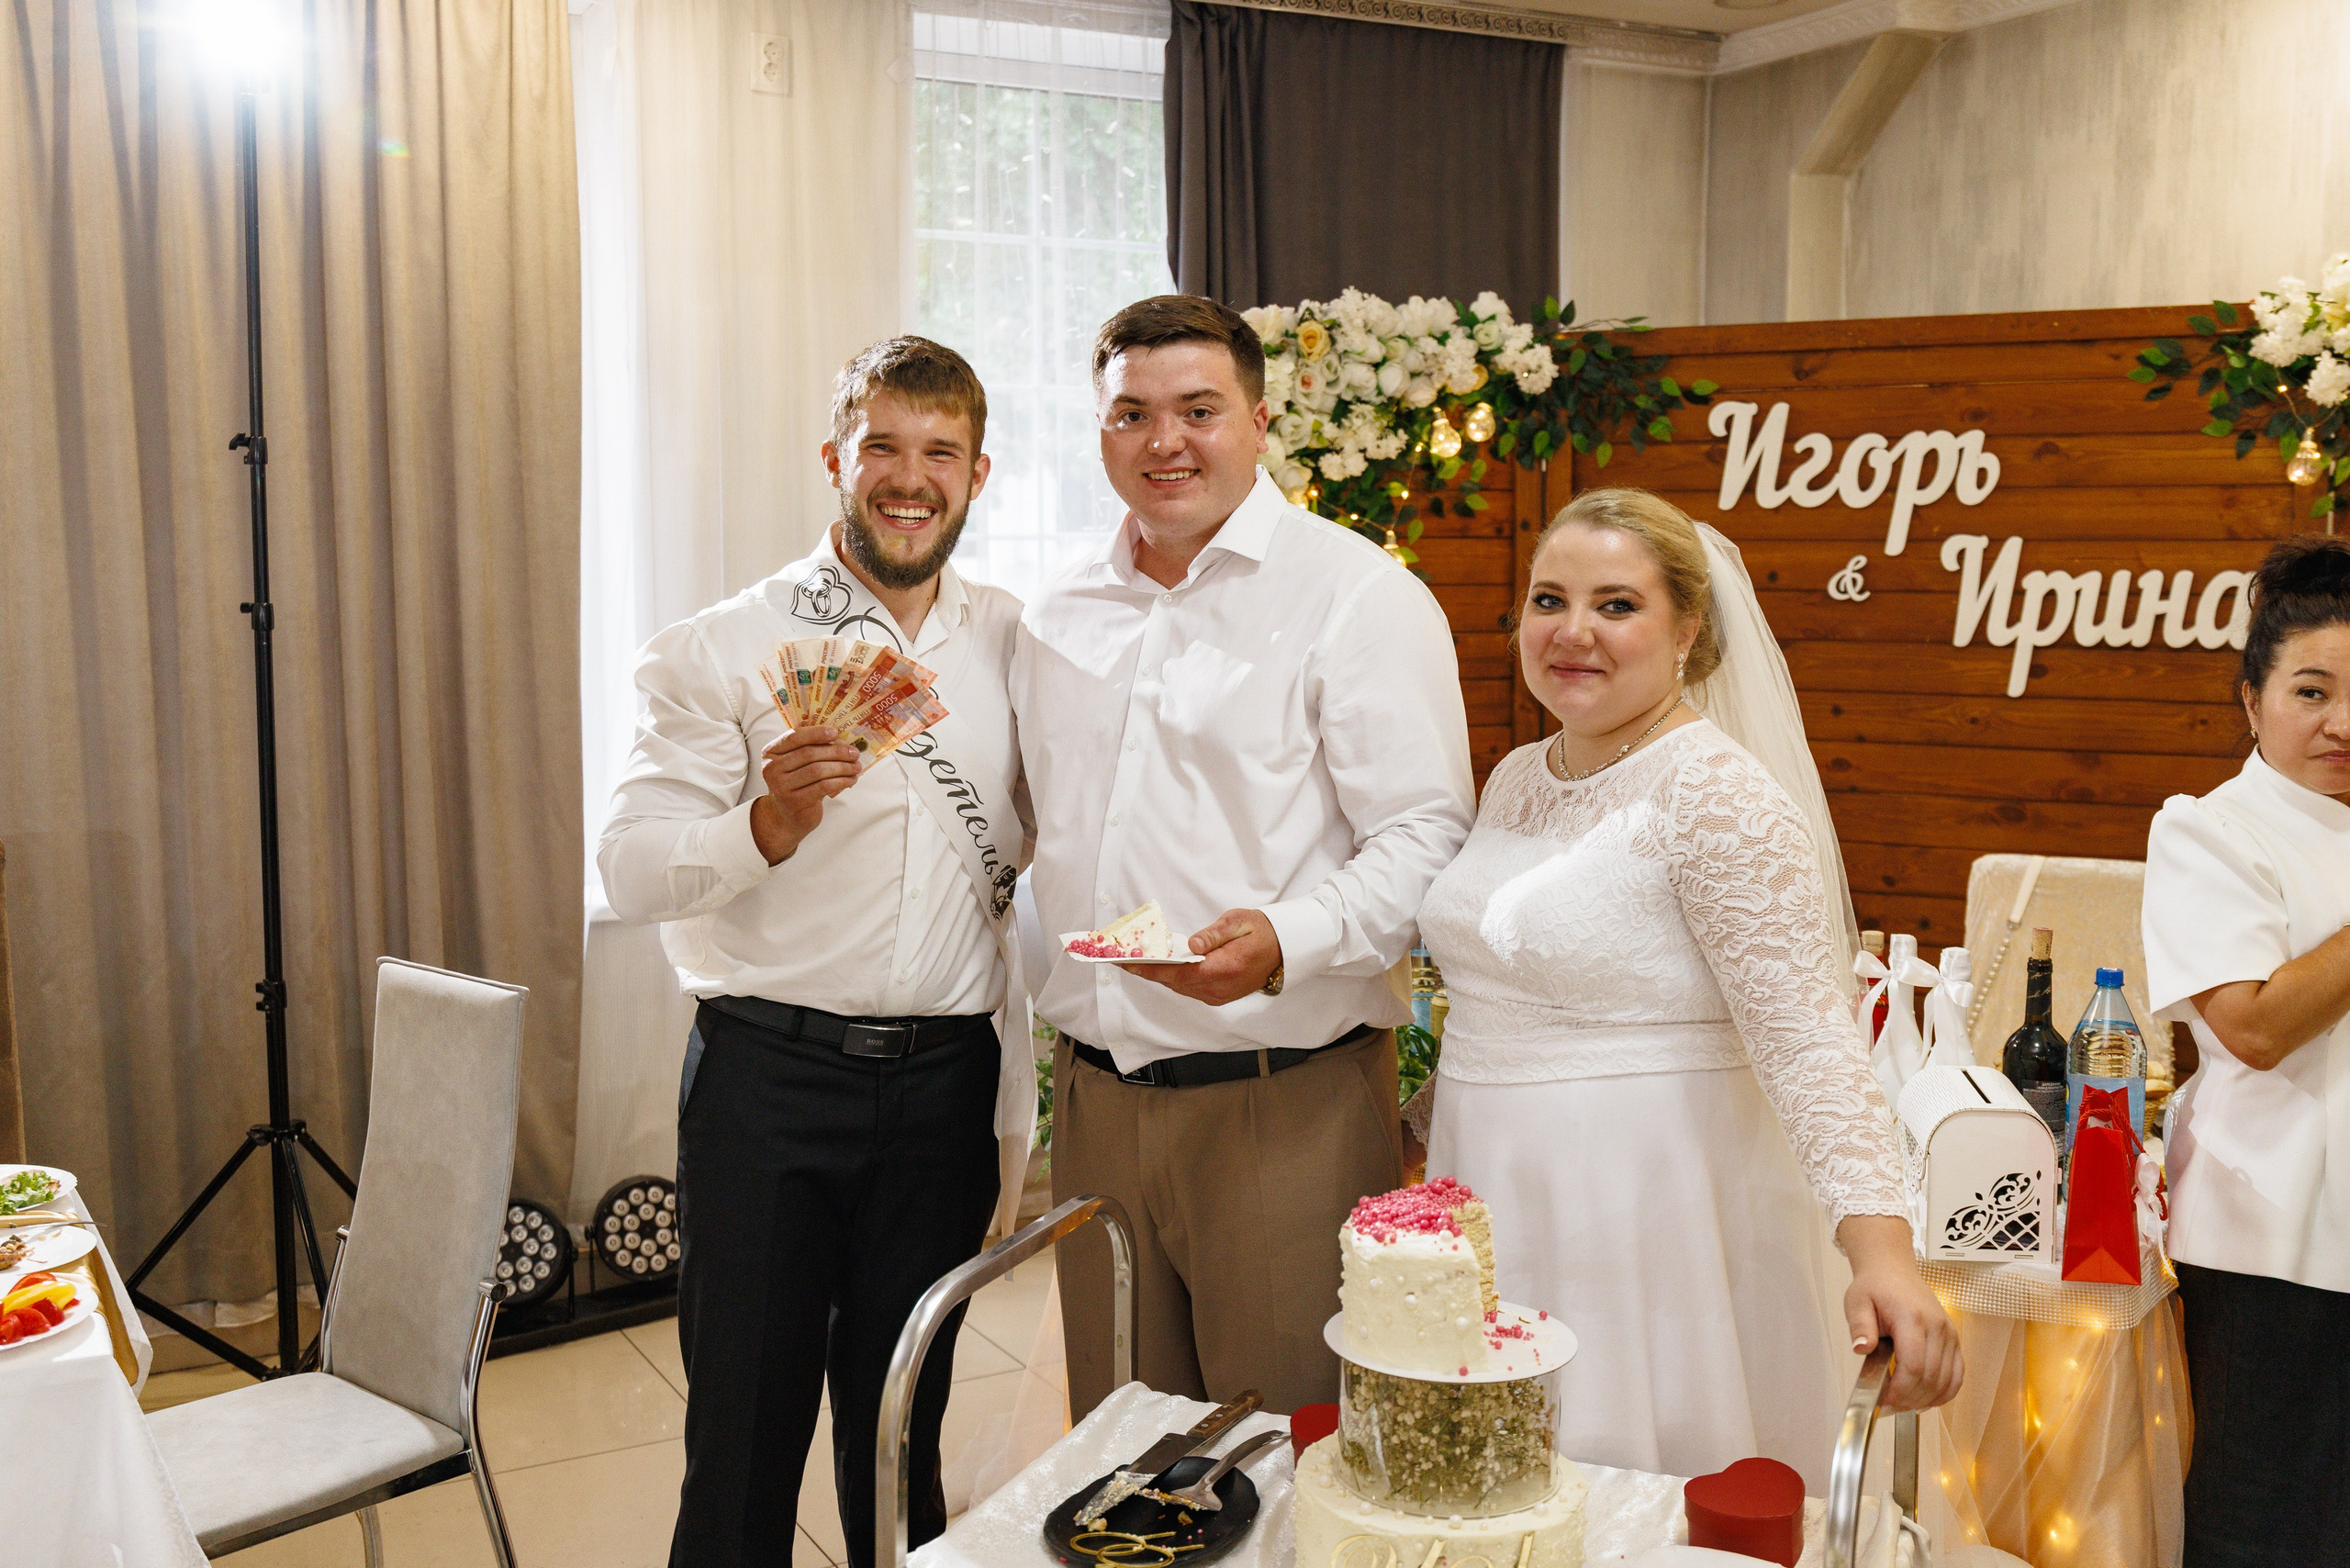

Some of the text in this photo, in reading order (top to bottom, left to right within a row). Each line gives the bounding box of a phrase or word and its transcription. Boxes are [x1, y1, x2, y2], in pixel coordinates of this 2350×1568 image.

[1708, 401, 2001, 556] Игорь
[1828, 555, 1872, 601] &
[1941, 534, 2256, 698] Ирина
[862, 670, 882, 692] 5000
[852, 708, 869, 722] ПЯТЬ
[875, 693, 898, 711] 5000
